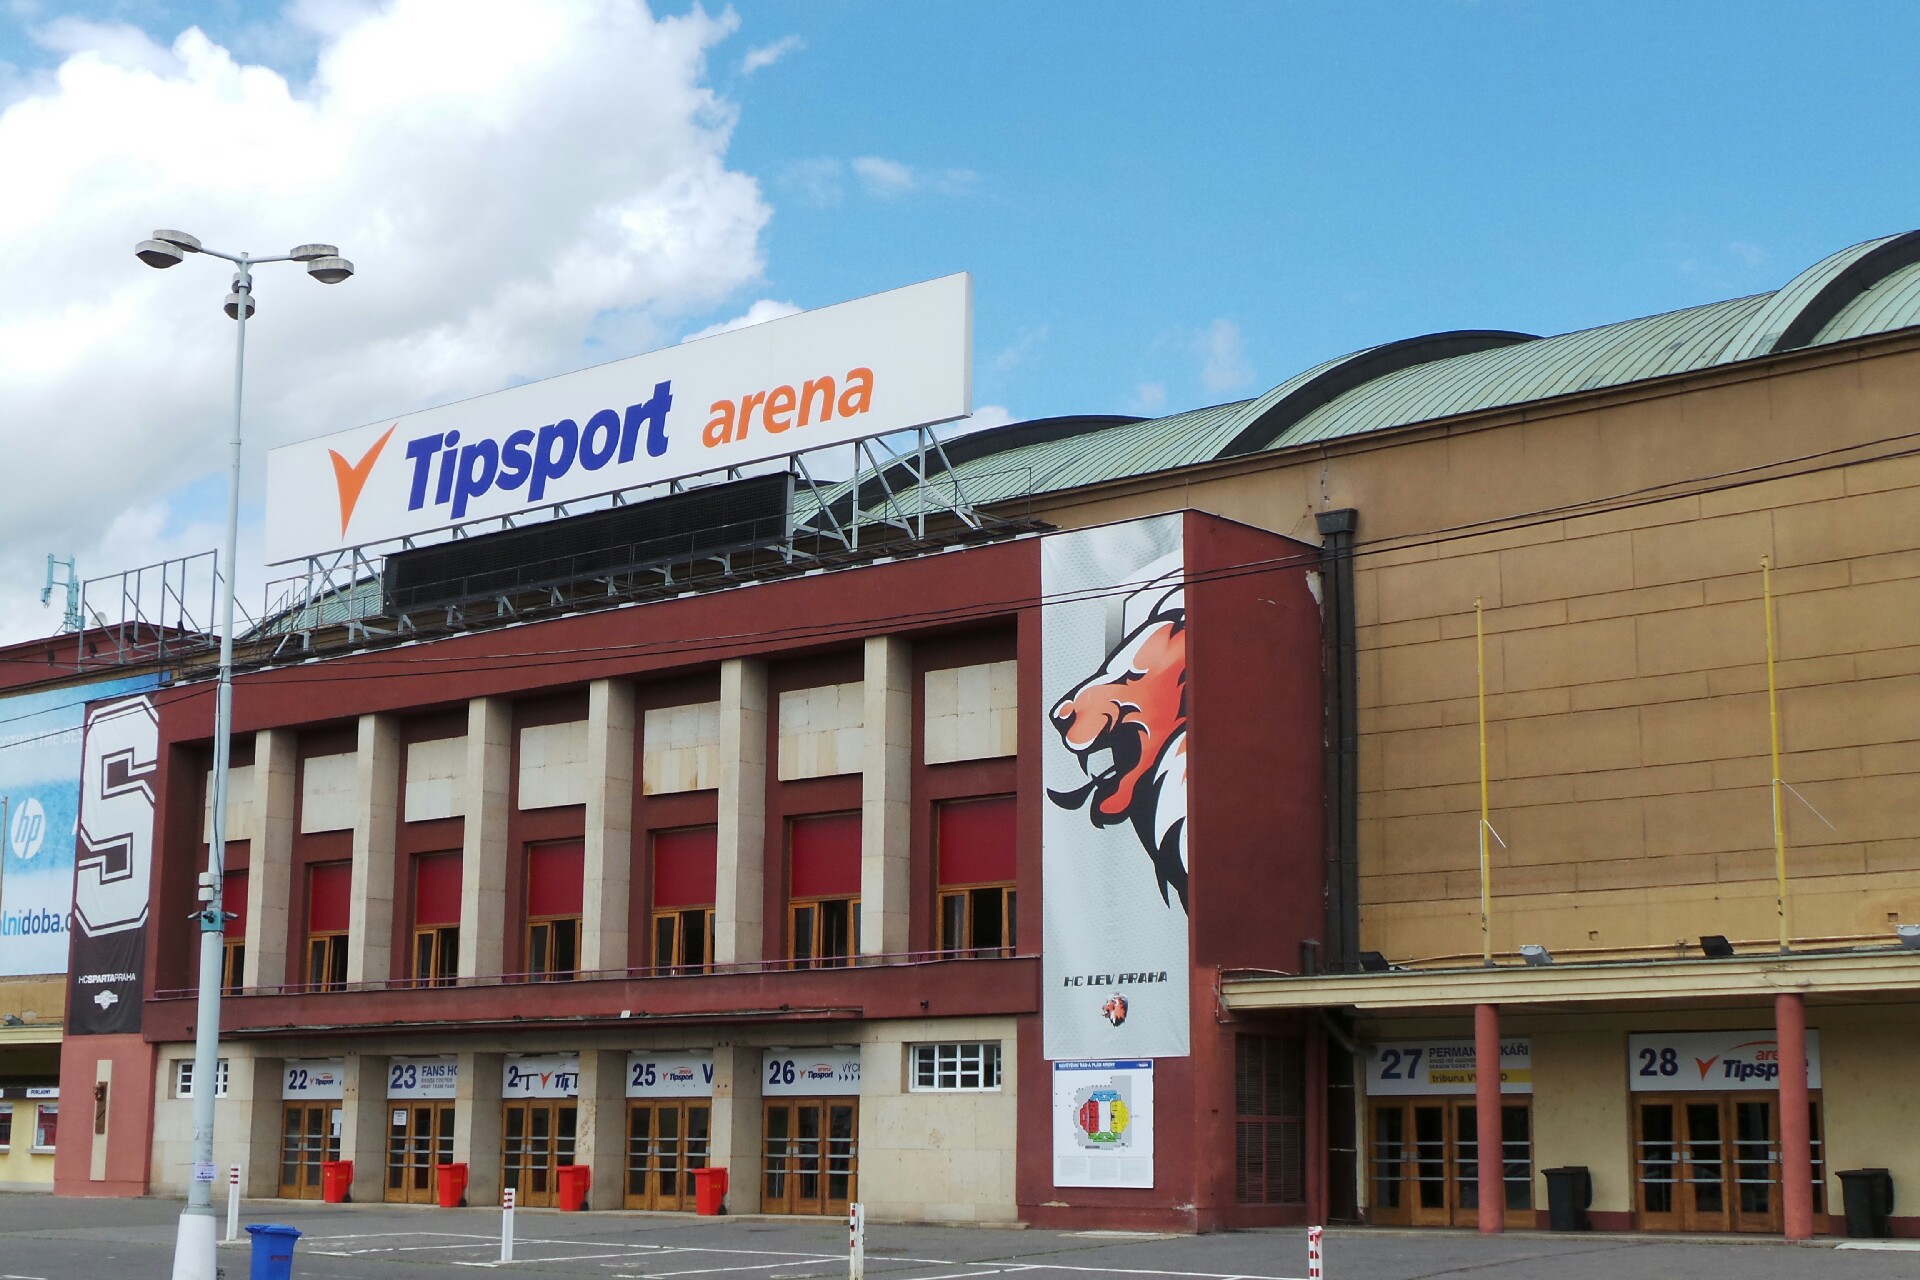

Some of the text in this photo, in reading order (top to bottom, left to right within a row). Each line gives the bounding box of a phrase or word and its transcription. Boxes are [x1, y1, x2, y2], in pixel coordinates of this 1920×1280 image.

[405, 368, 874, 520] Tipsport arena
[75, 694, 159, 938] S
[13, 798, 43, 859] hp
[0, 908, 71, 936] lnidoba.c
[1063, 970, 1168, 987] HC LEV PRAHA
[1429, 1044, 1528, 1058] PERMANKÁŘI
[1639, 1048, 1679, 1077] 28
[421, 1065, 445, 1077] FANS
[632, 1063, 656, 1087] 25
[768, 1060, 795, 1085] 26
[807, 1071, 834, 1080] Tipsport
[1380, 1048, 1423, 1080] 27
[288, 1069, 308, 1090] 22
[390, 1064, 417, 1089] 23
[507, 1065, 522, 1088] 2
[669, 1073, 694, 1082] Tipsport
[1432, 1073, 1465, 1083] tribuna
